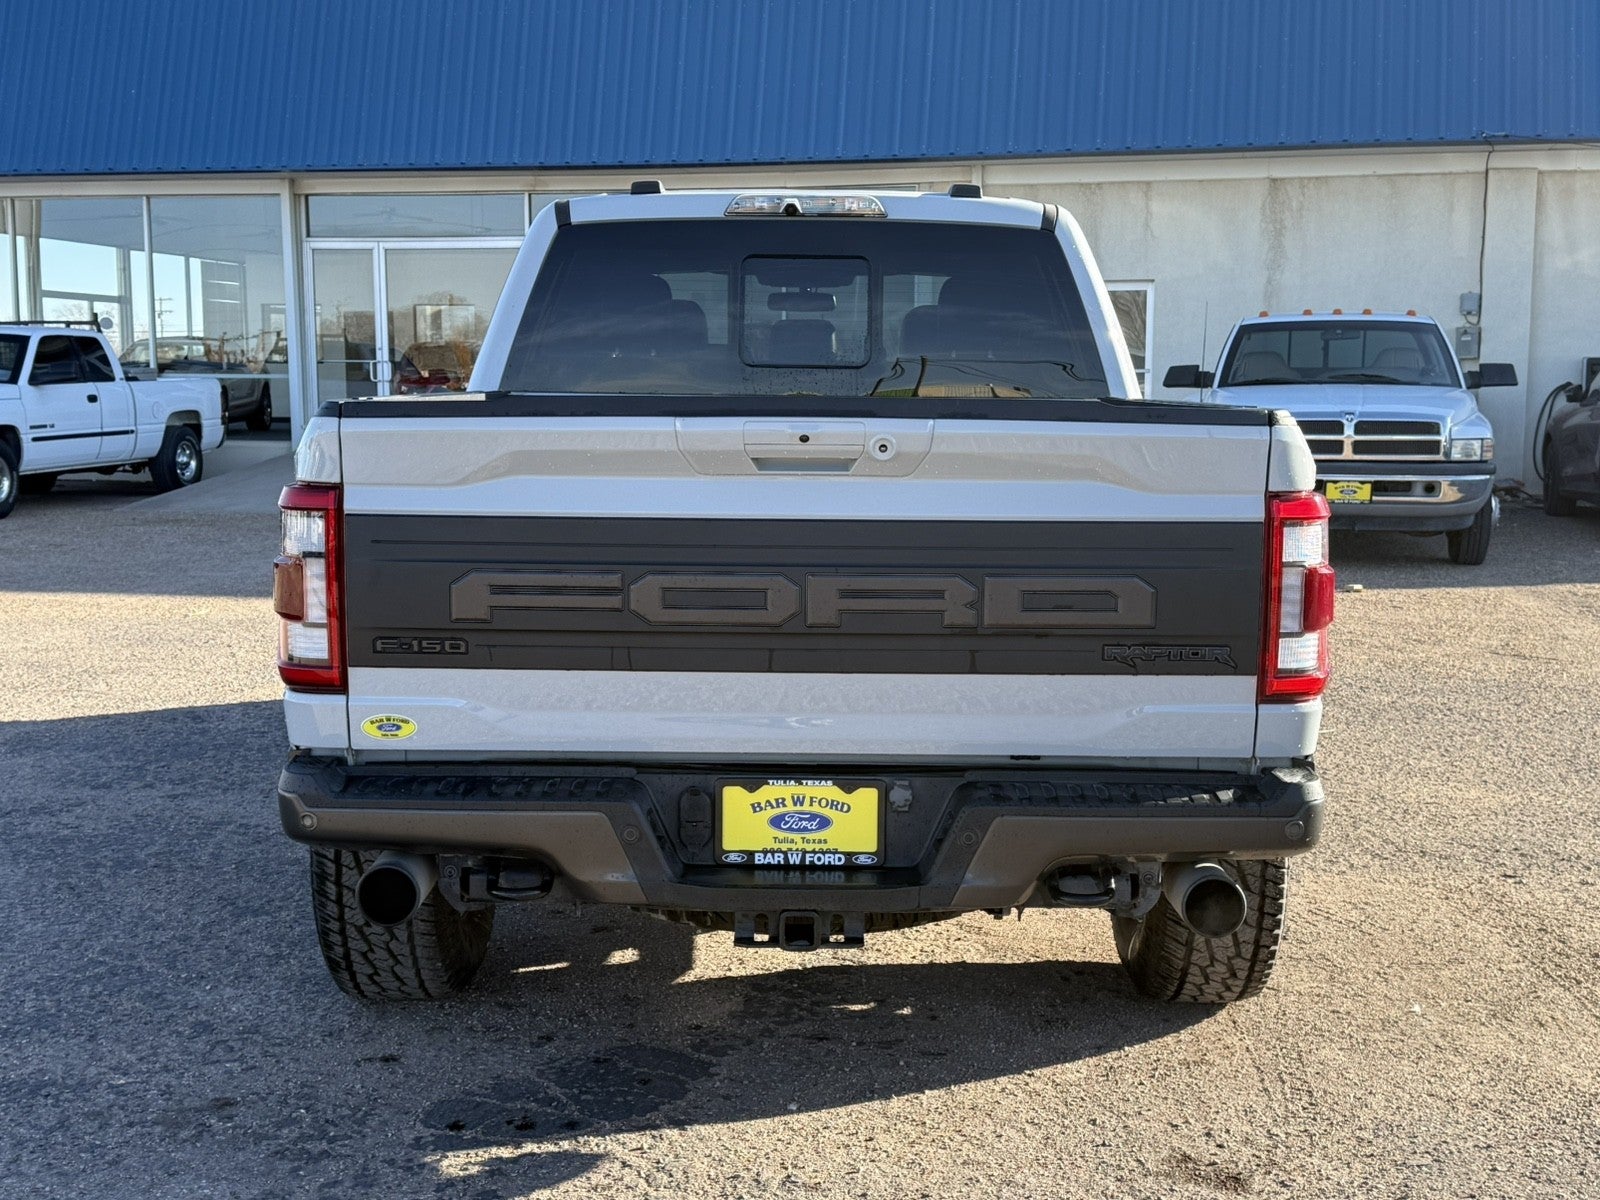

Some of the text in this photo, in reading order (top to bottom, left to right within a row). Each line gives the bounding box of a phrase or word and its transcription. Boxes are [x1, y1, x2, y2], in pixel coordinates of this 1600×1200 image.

[449, 568, 1158, 629] FORD
[375, 638, 467, 654] F-150
[1102, 644, 1238, 669] RAPTOR
[750, 793, 852, 814] BAR W FORD
[780, 813, 820, 830] Ford
[773, 836, 798, 845] Tulia,
[754, 851, 846, 866] BAR W FORD
